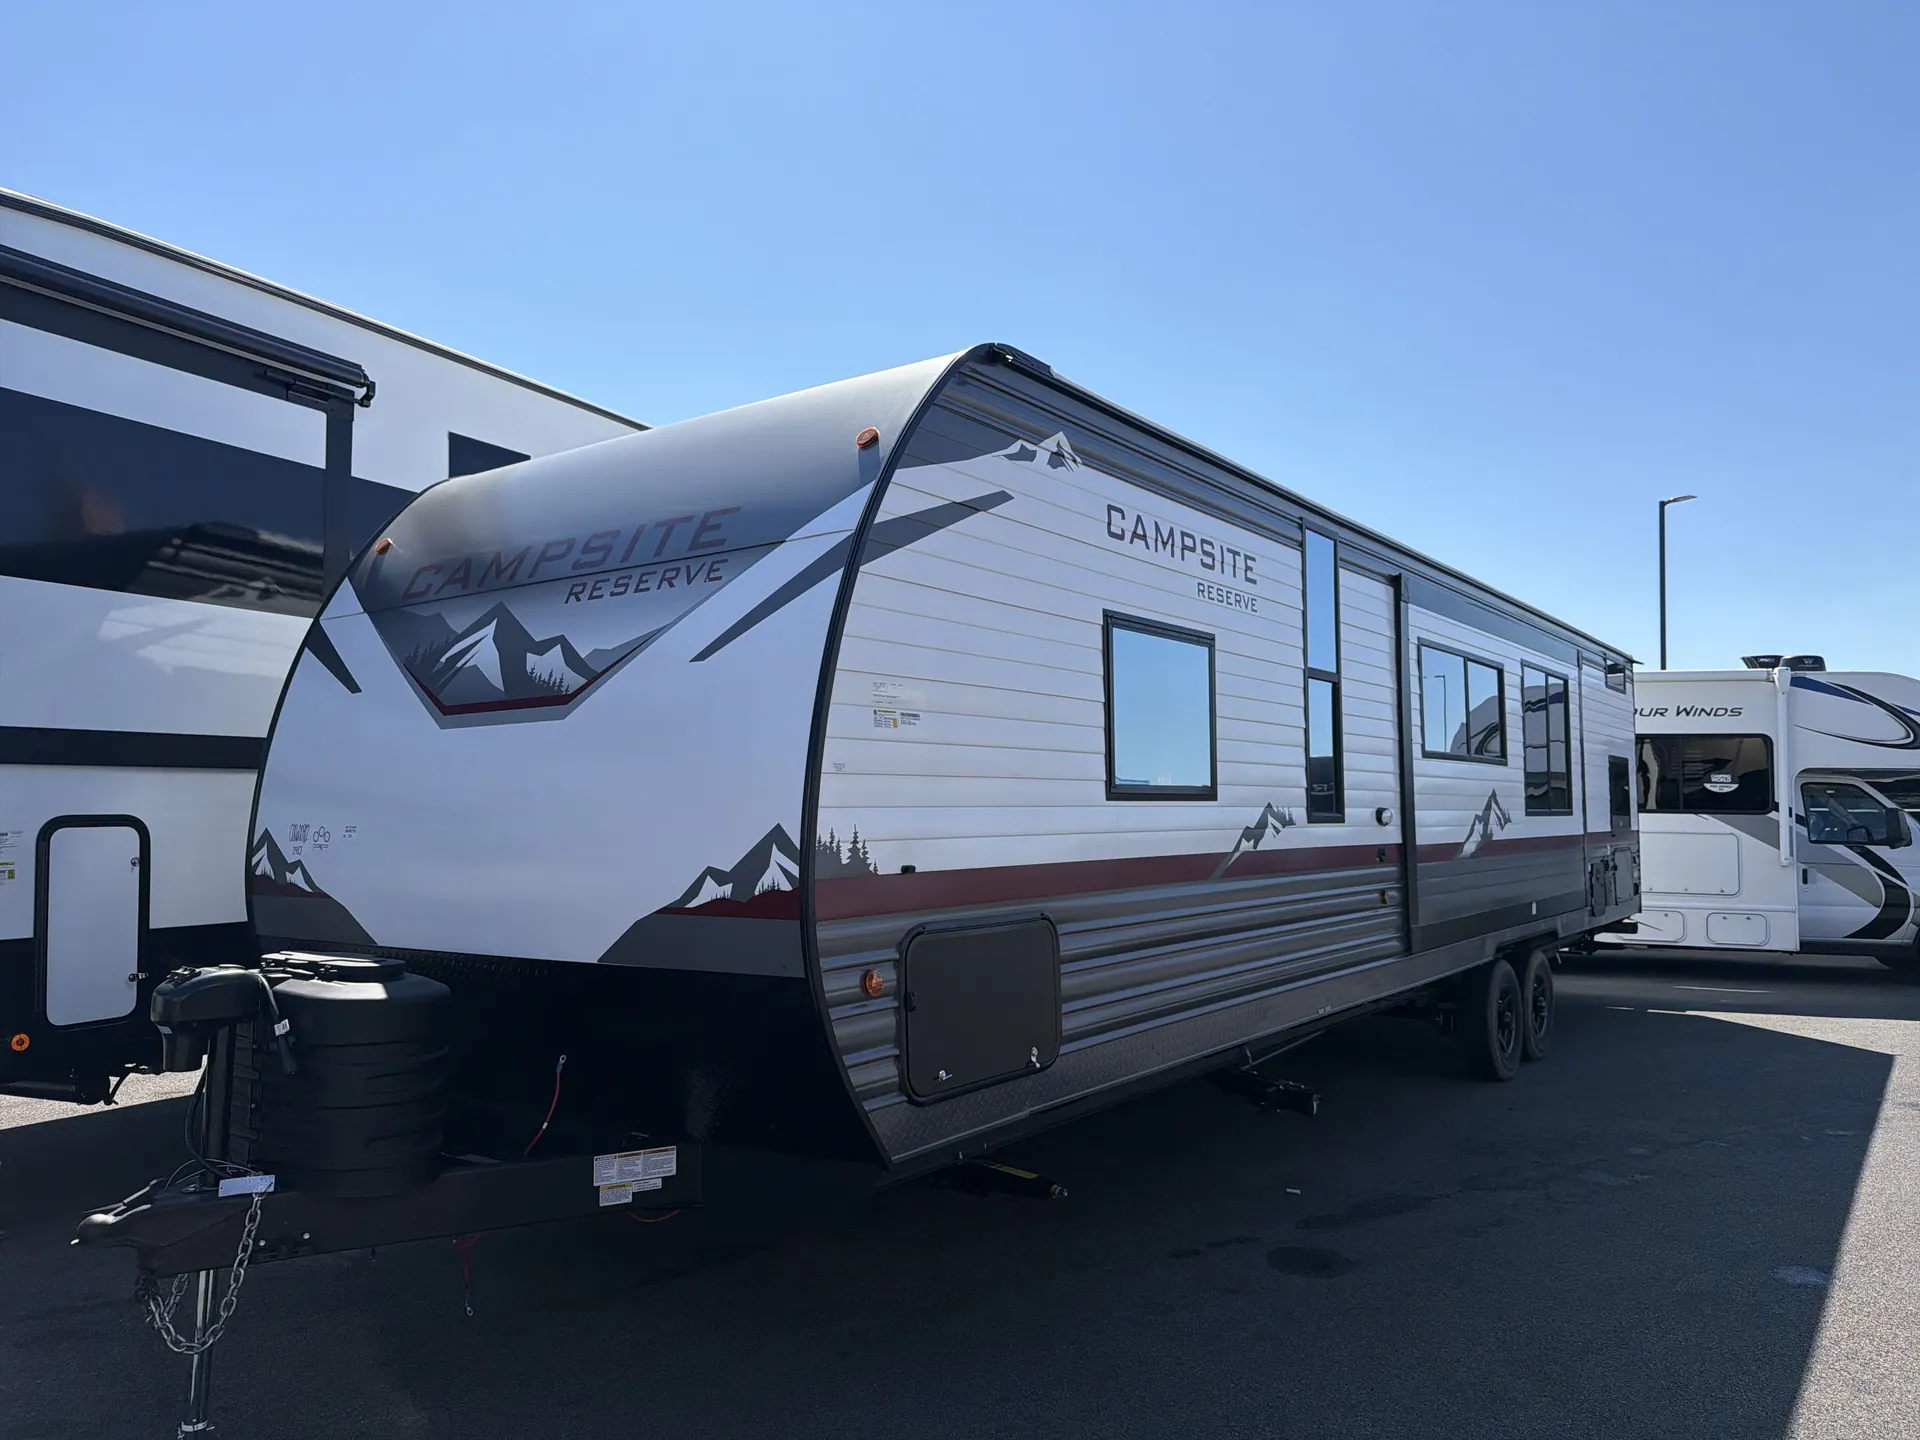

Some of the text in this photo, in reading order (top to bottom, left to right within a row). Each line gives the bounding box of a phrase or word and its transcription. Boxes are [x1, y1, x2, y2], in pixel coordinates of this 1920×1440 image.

[401, 505, 743, 600] CAMPSITE
[1106, 503, 1258, 585] CAMPSITE
[564, 558, 730, 604] RESERVE
[1197, 581, 1258, 613] RESERVE
[1633, 705, 1744, 717] UR WINDS
